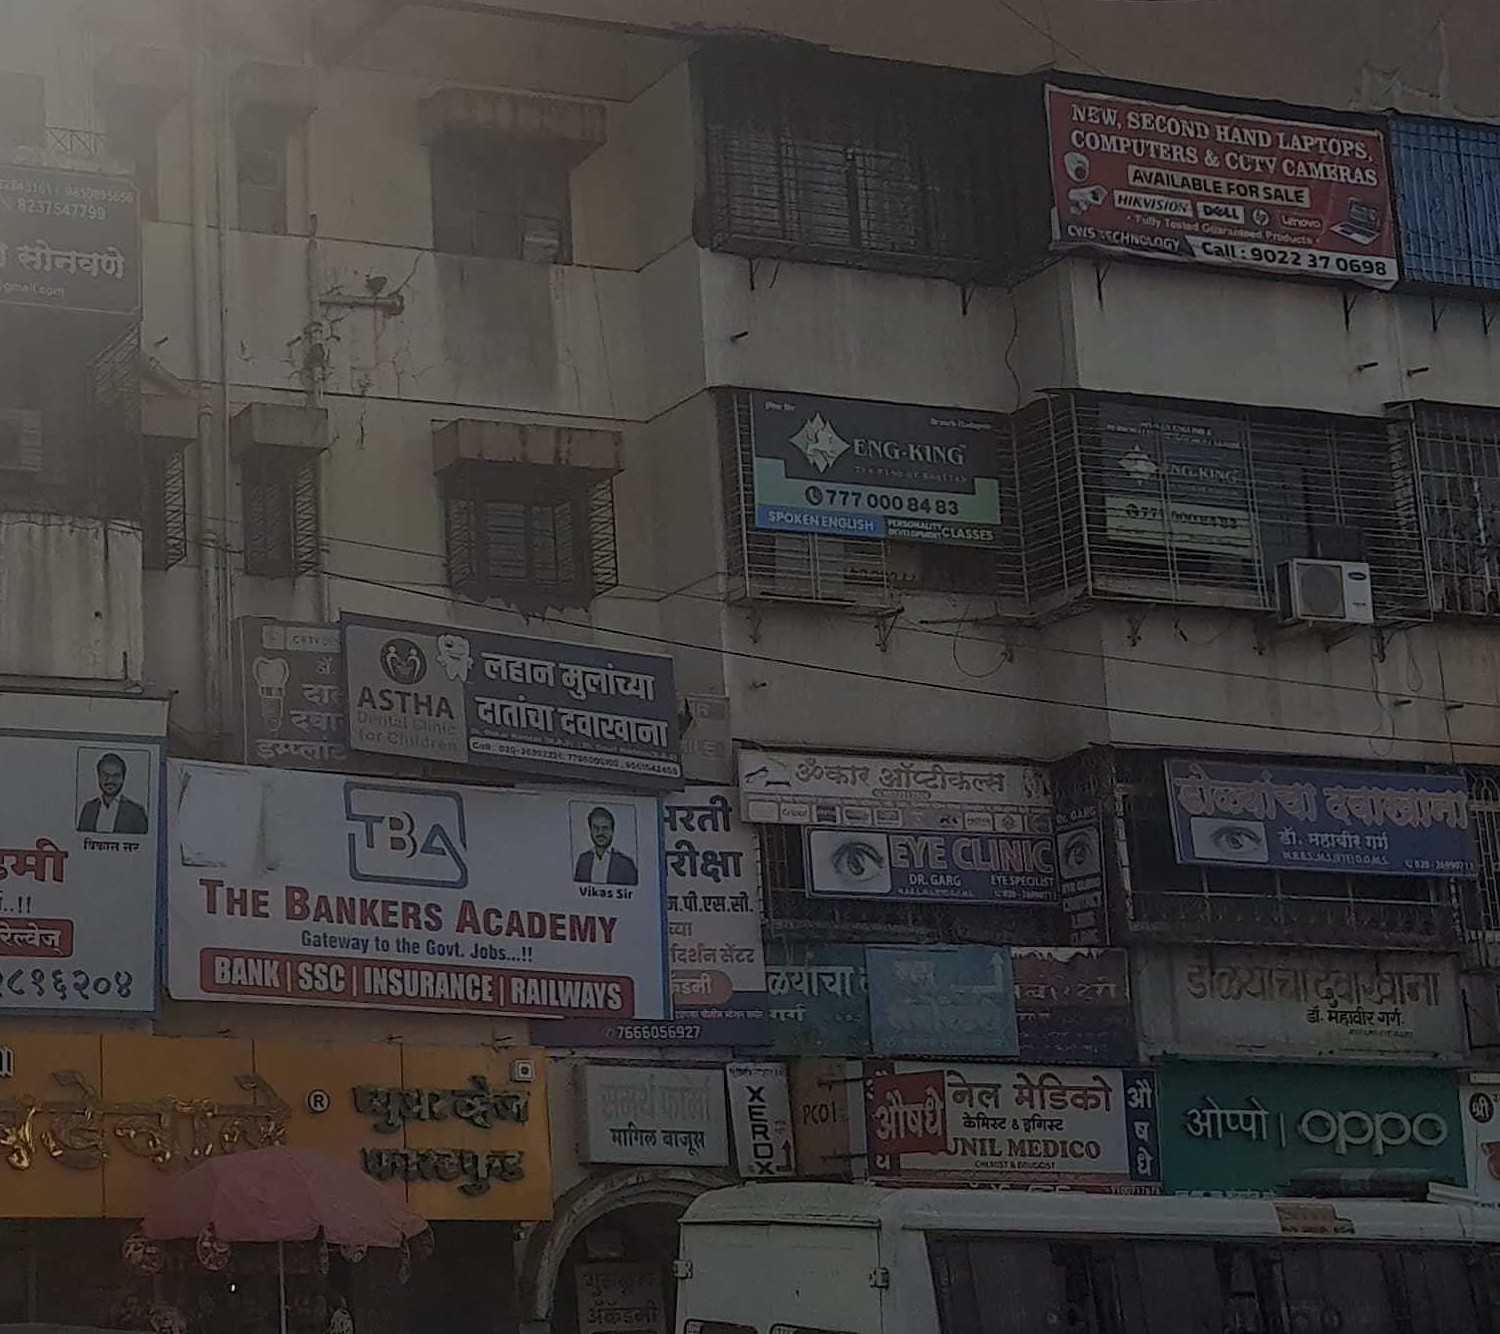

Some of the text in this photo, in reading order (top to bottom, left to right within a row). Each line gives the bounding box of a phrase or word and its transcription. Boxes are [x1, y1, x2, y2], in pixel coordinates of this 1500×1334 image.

[1071, 104, 1374, 163] NEW, SECOND HAND LAPTOPS,
[1071, 130, 1379, 187] COMPUTERS & CCTV CAMERAS
[1132, 167, 1305, 204] AVAILABLE FOR SALE
[1117, 194, 1188, 214] HIKVISION
[1203, 204, 1240, 221] DELL
[1281, 214, 1321, 229] Lenovo
[17, 240, 126, 279] सोनवणे
[1203, 241, 1387, 276] Call 9022 37 0698
[853, 437, 966, 466] ENG-KING
[826, 489, 960, 516] 777 000 84 83
[768, 510, 994, 542] SPOKEN ENGLISH CLASSES
[481, 652, 656, 701] लहान मुलांच्या
[357, 685, 456, 720] ASTHA
[475, 695, 554, 732] दातांचा
[557, 707, 669, 748] दवाखाना
[1323, 782, 1468, 830] दवाखाना
[889, 833, 1054, 874] EYE CLINIC
[1307, 828, 1361, 850] महावीर
[1364, 830, 1389, 851] गर्ग
[666, 839, 743, 883] रीक्षा
[579, 886, 634, 900] Vikas Sir
[930, 873, 962, 888] GARG
[199, 878, 618, 945] THE BANKERS ACADEMY
[301, 930, 369, 955] Gateway
[375, 938, 391, 953] to
[401, 937, 421, 955] the
[426, 939, 465, 959] Govt.
[214, 955, 623, 1011] BANK SSC INSURANCE RAILWAYS
[616, 1025, 701, 1040] 7666056927
[1327, 1003, 1374, 1026] महावीर
[1013, 1071, 1114, 1113] मेडिको
[746, 1085, 775, 1176] XEROX
[871, 1084, 945, 1142] औषधे
[1011, 1117, 1020, 1131] &
[1186, 1093, 1270, 1141] ओप्पो
[1300, 1107, 1449, 1157] oppo
[947, 1137, 1101, 1161] UNIL MEDICO
